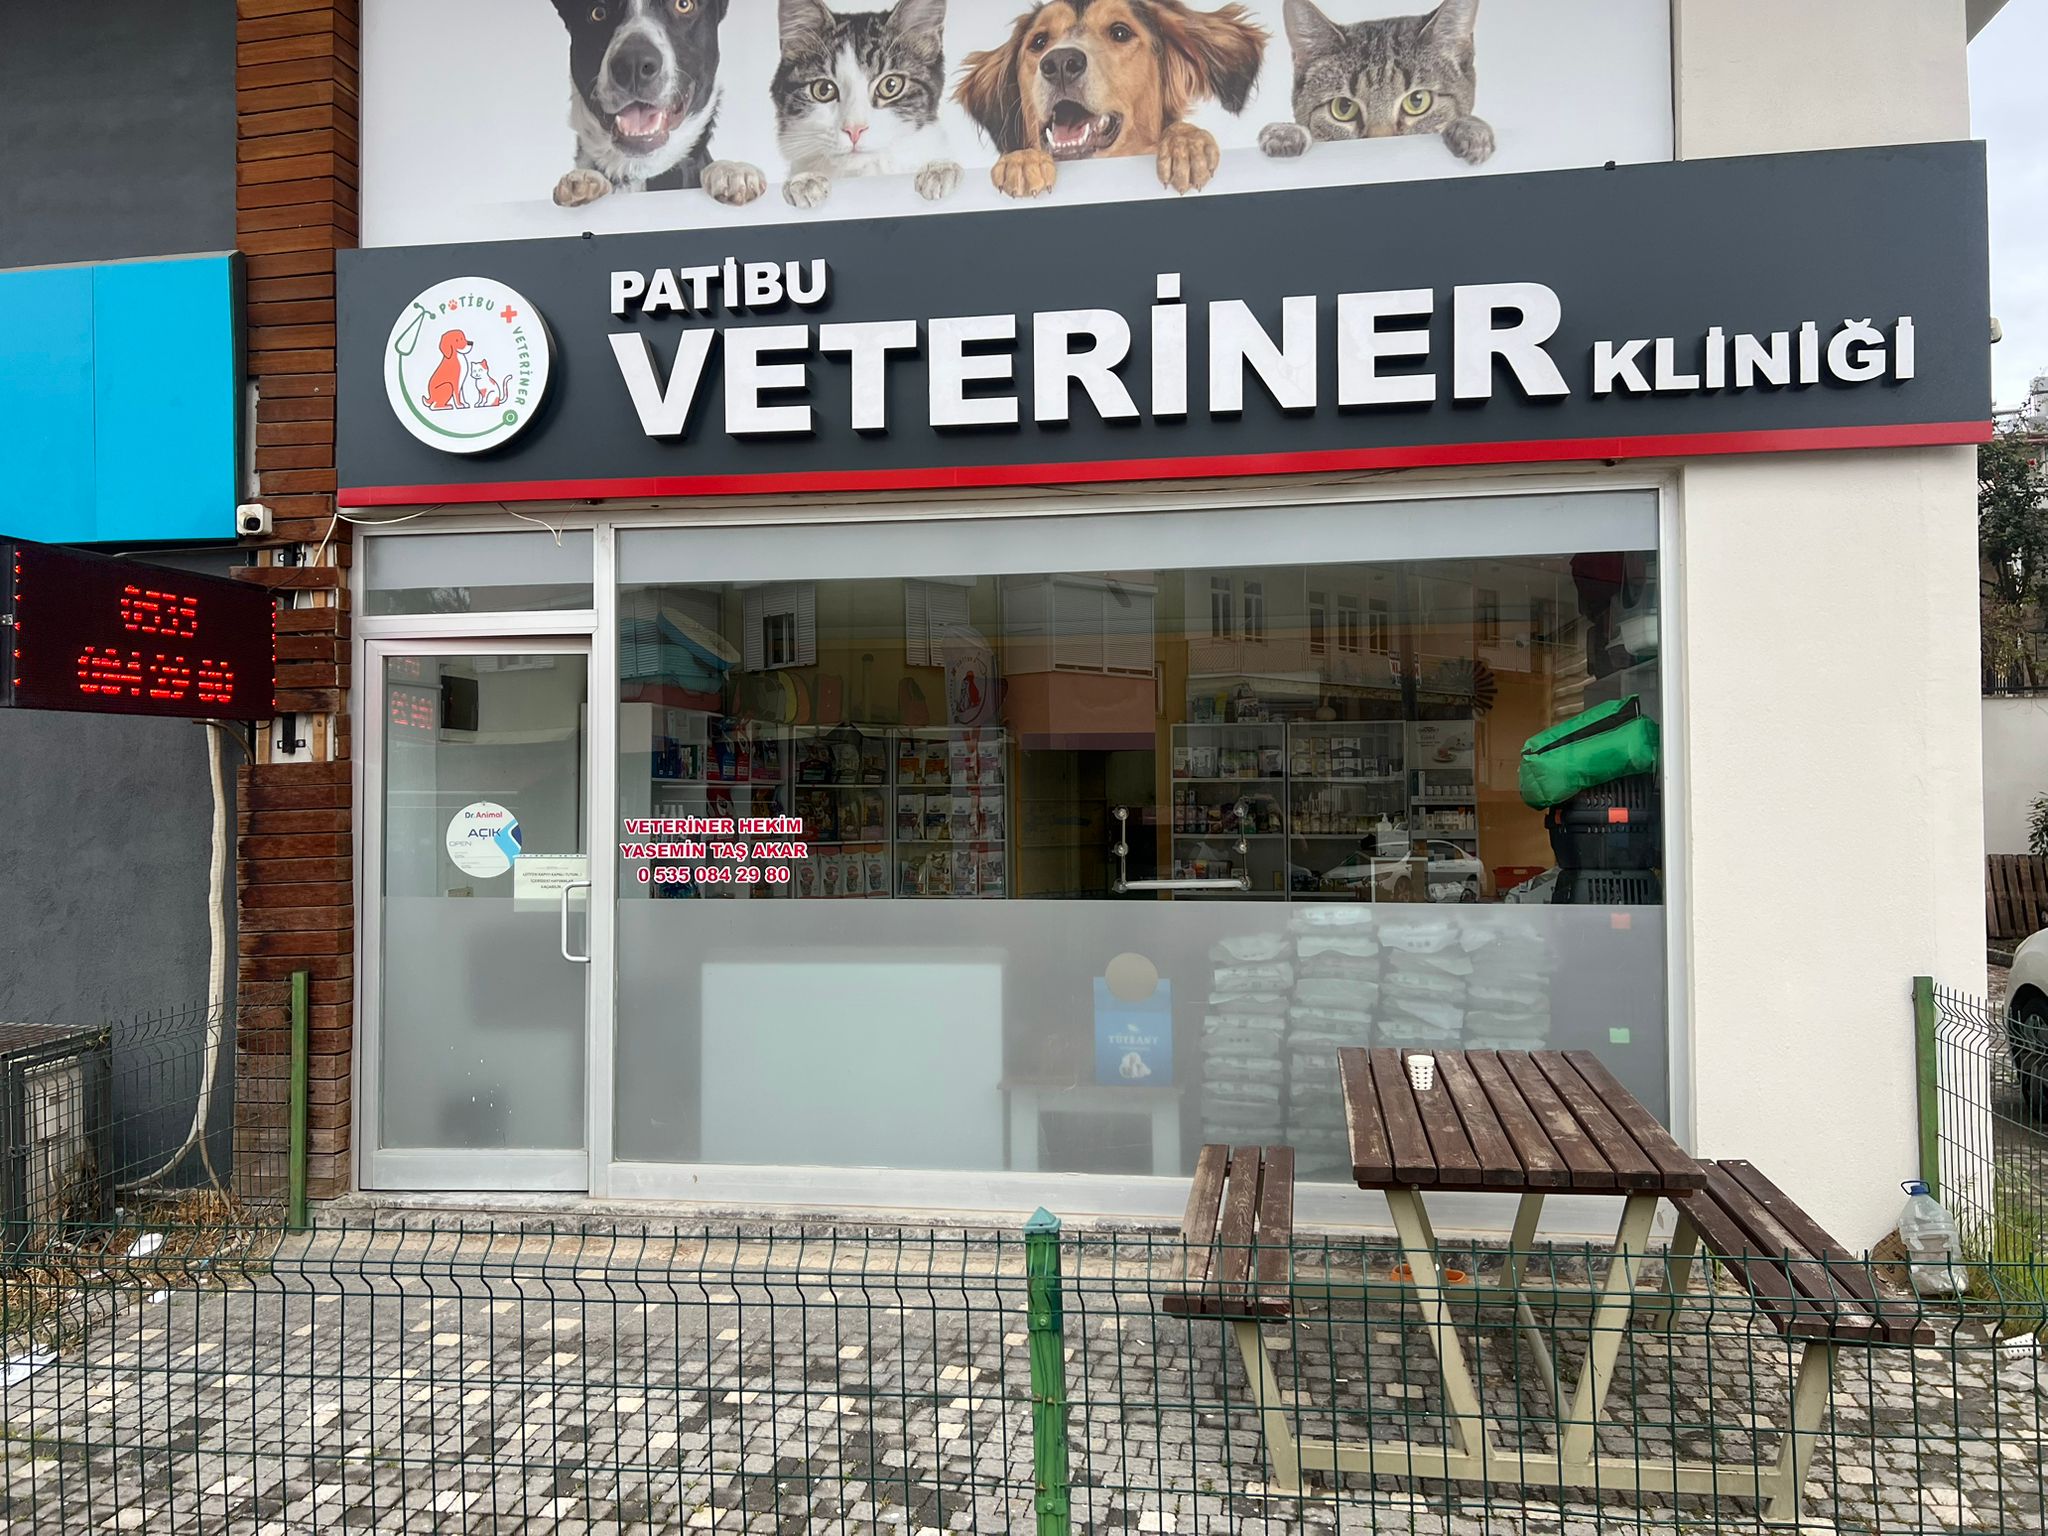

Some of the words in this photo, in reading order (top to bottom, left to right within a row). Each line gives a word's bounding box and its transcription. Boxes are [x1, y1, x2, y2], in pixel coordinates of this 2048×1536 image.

[609, 256, 827, 315] PATİBU
[438, 293, 495, 315] PTİBU
[607, 271, 1571, 437] VETERİNER
[1593, 315, 1915, 394] KLİNİĞİ
[512, 326, 533, 406] VETERİNER
[467, 828, 501, 840] AÇIK
[624, 815, 735, 835] VETERİNER
[739, 814, 803, 834] HEKİM
[619, 840, 706, 859] YASEMİN
[710, 842, 749, 862] TAŞ
[752, 842, 809, 859] AKAR
[636, 867, 650, 884] 0
[654, 866, 691, 883] 535
[694, 866, 731, 883] 084
[735, 866, 760, 883] 29
[764, 866, 790, 883] 80
